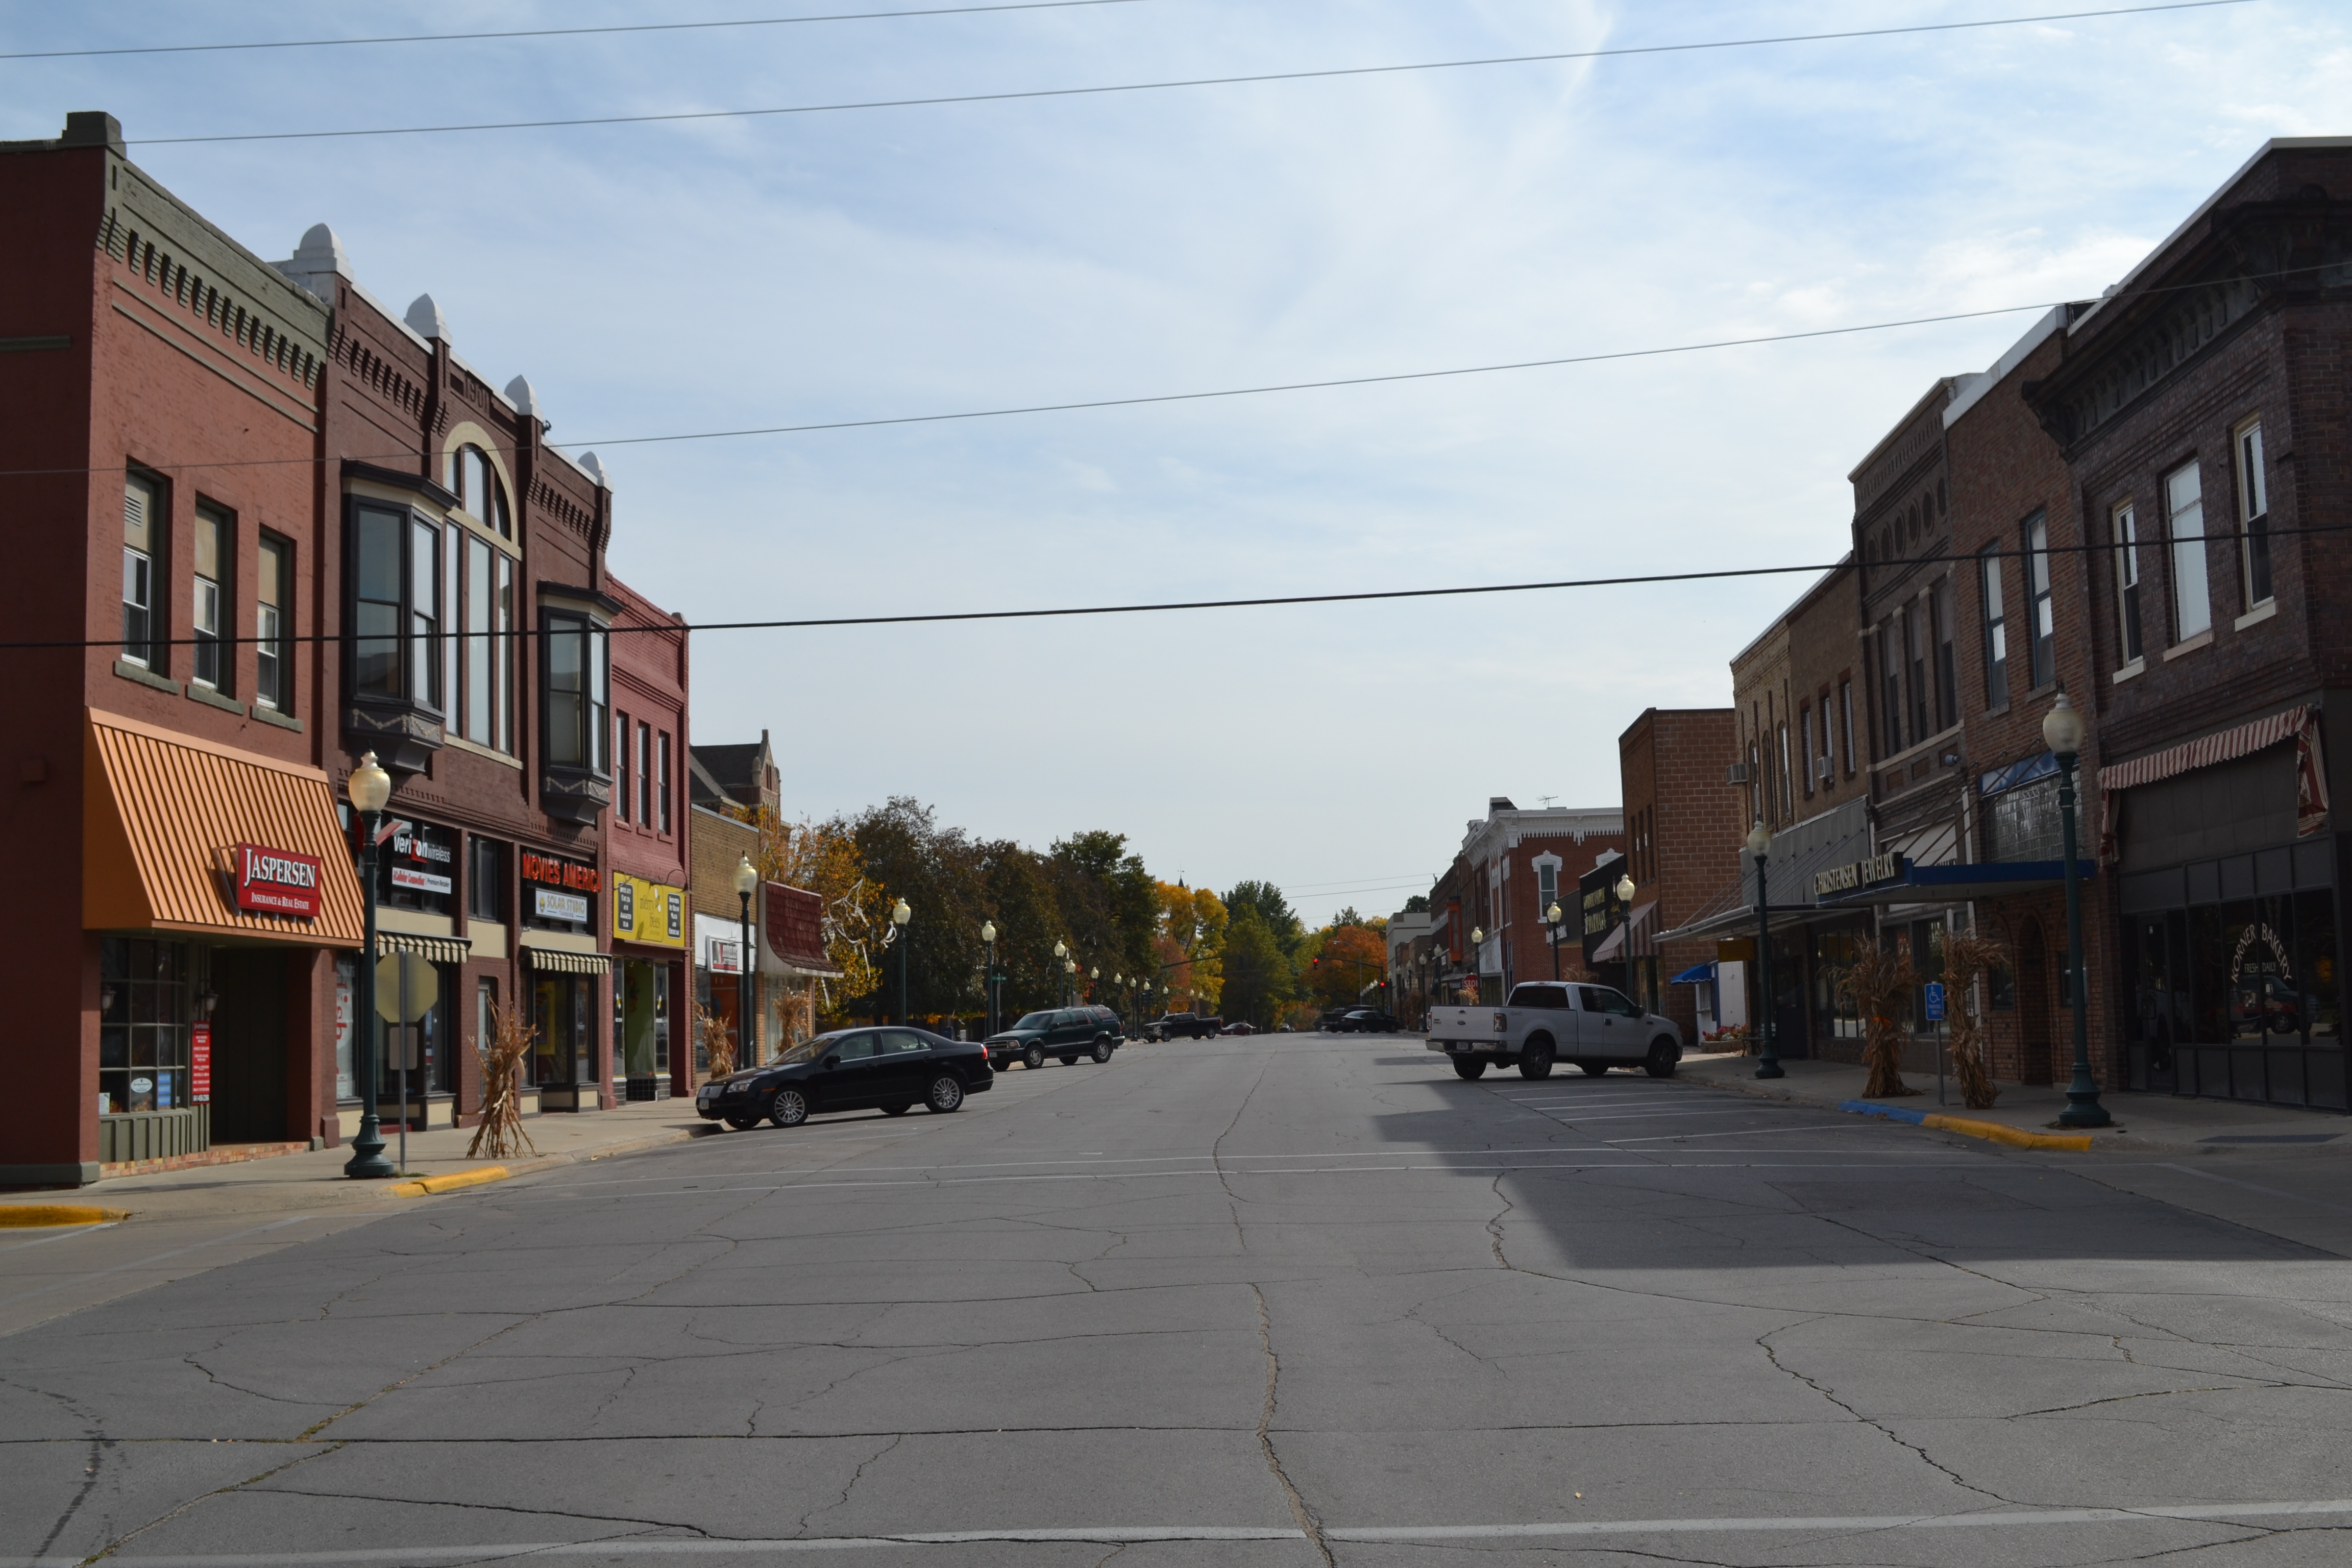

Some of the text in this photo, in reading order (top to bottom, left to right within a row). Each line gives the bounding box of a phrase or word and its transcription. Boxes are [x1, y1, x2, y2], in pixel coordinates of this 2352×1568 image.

[465, 378, 488, 413] 1901
[244, 848, 315, 888] JASPERSEN
[522, 853, 601, 893] MOVIES AMERICA
[1814, 853, 1895, 895] CHRISTENSEN JEWELRY
[251, 892, 309, 910] INSURANCE & REAL ESTATE
[547, 895, 585, 914] SOLAR STUDIO
[2231, 922, 2292, 984] KORNER BAKERY
[2244, 962, 2276, 973] FRESH DAILY
